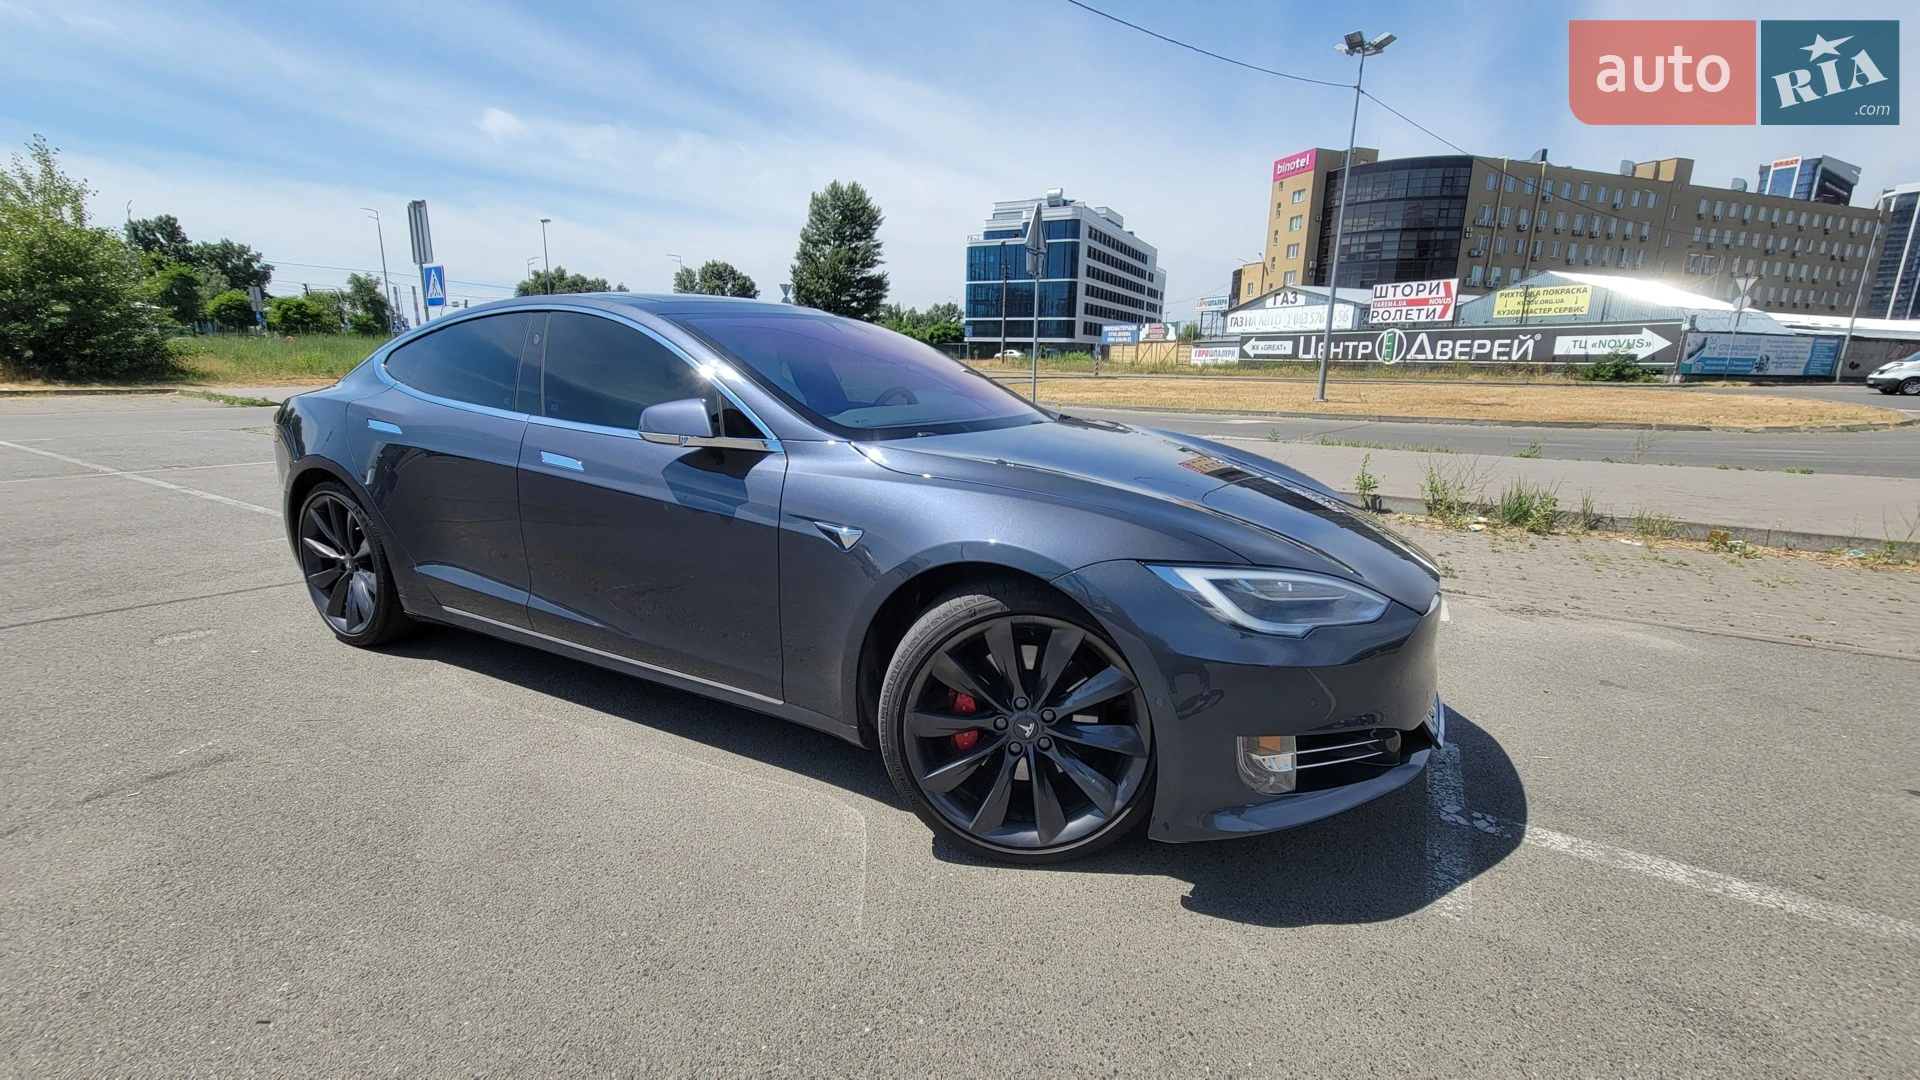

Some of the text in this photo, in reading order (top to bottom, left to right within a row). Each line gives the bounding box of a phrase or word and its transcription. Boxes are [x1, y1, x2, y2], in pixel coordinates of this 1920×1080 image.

[1277, 153, 1310, 175] binotel
[1373, 281, 1441, 299] ШТОРИ
[1542, 286, 1588, 296] ПОКРАСКА
[1272, 290, 1298, 306] ГАЗ
[1373, 299, 1407, 308] YAREMA.UA
[1428, 297, 1453, 305] NOVUS
[1370, 307, 1437, 322] РОЛЕТИ
[1497, 308, 1521, 316] КУЗОВ
[1553, 305, 1585, 314] СЕРВИС
[1230, 316, 1244, 328] ГАЗ
[1571, 339, 1588, 350] ТЦ
